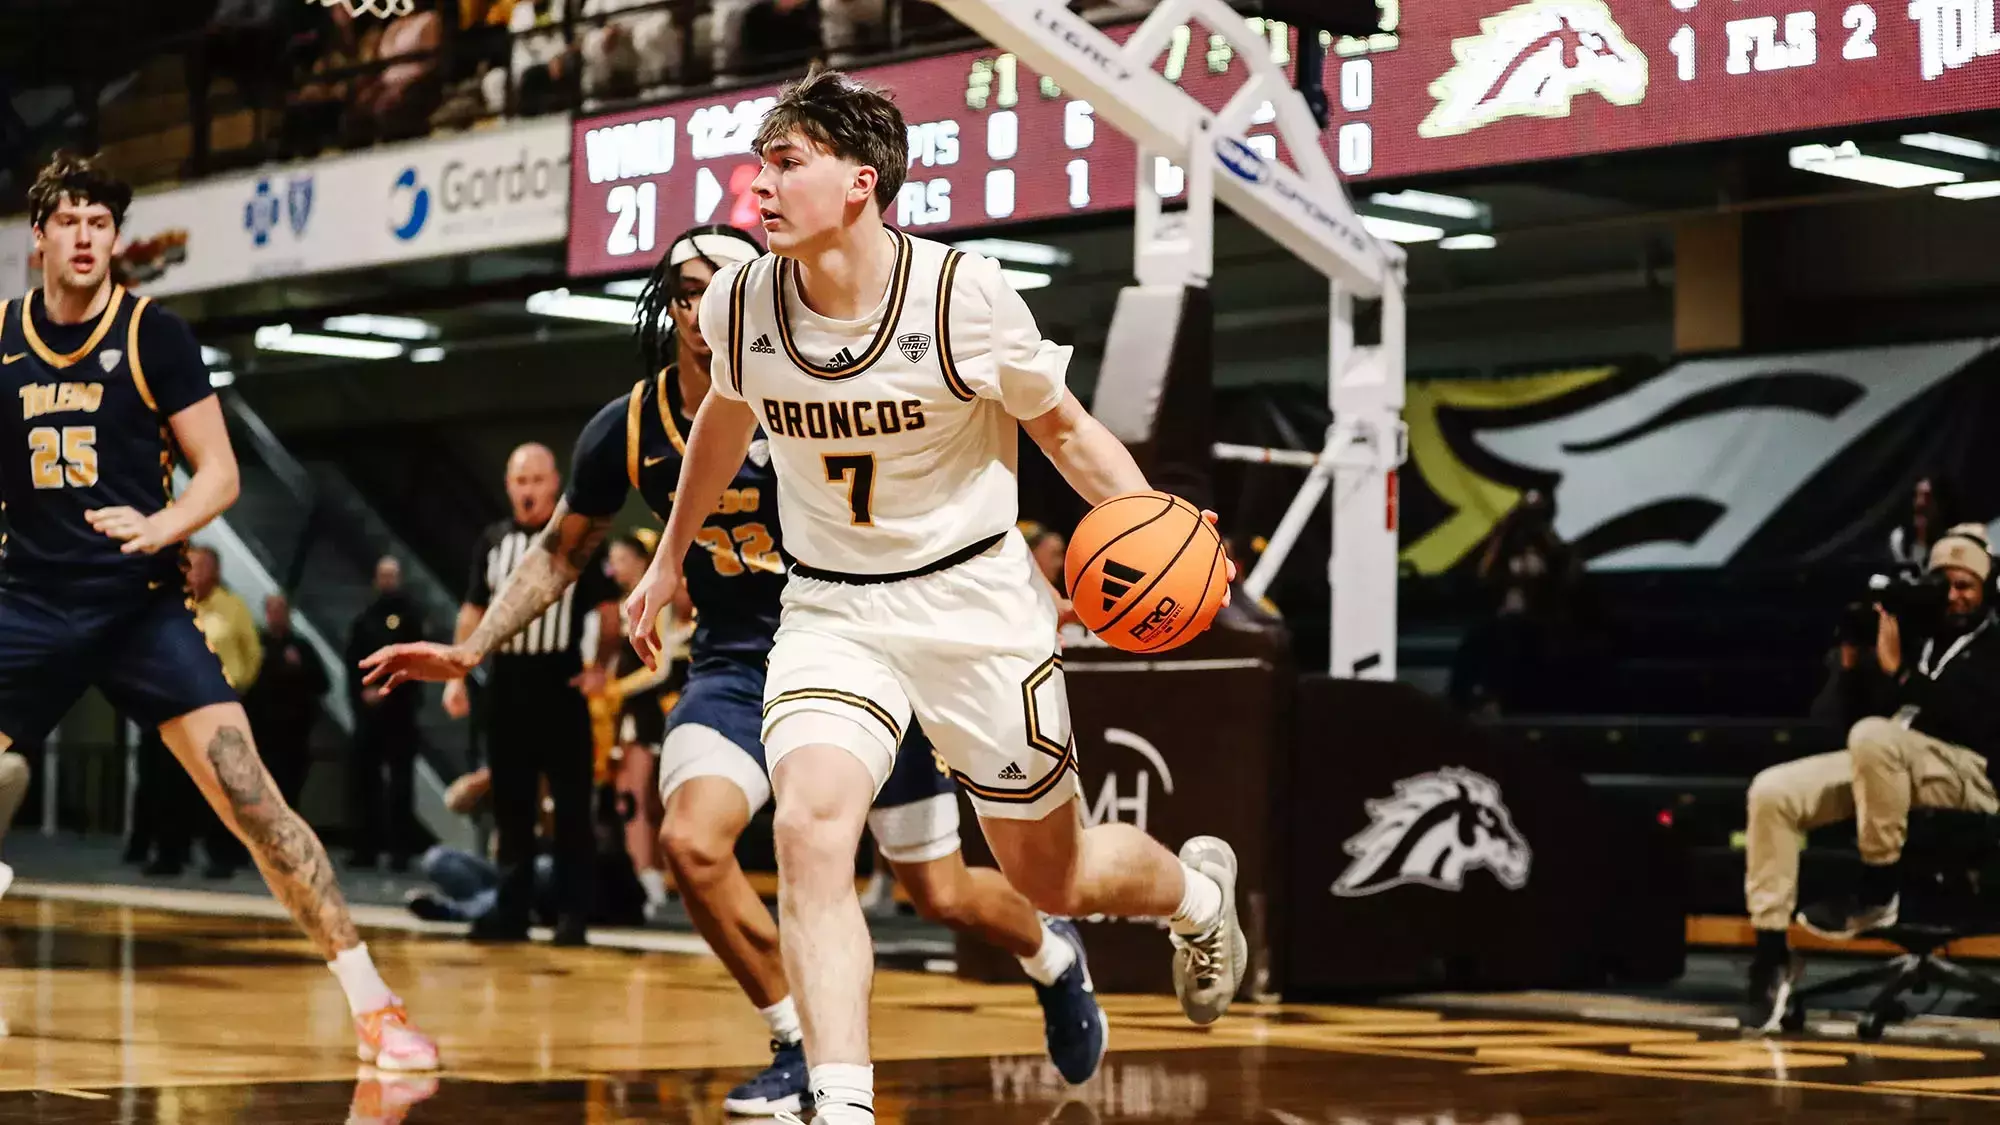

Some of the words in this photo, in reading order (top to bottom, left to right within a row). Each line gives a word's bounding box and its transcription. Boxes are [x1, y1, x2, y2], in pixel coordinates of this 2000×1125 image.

[1034, 8, 1132, 81] LEGACY
[1725, 10, 1817, 75] FLS
[1842, 3, 1877, 60] 2
[987, 110, 1018, 160] 0
[1064, 99, 1094, 149] 6
[1341, 59, 1372, 111] 0
[985, 168, 1015, 218] 0
[1065, 158, 1090, 208] 1
[1339, 122, 1372, 175] 0
[606, 181, 657, 256] 21
[750, 345, 776, 354] adidas
[900, 342, 928, 350] MAC
[19, 382, 104, 421] TOLEDO
[763, 399, 926, 438] BRONCOS
[28, 426, 99, 489] 25
[821, 451, 877, 527] 7
[694, 522, 787, 576] 32
[1128, 596, 1176, 641] PRO
[998, 772, 1027, 780] adidas
